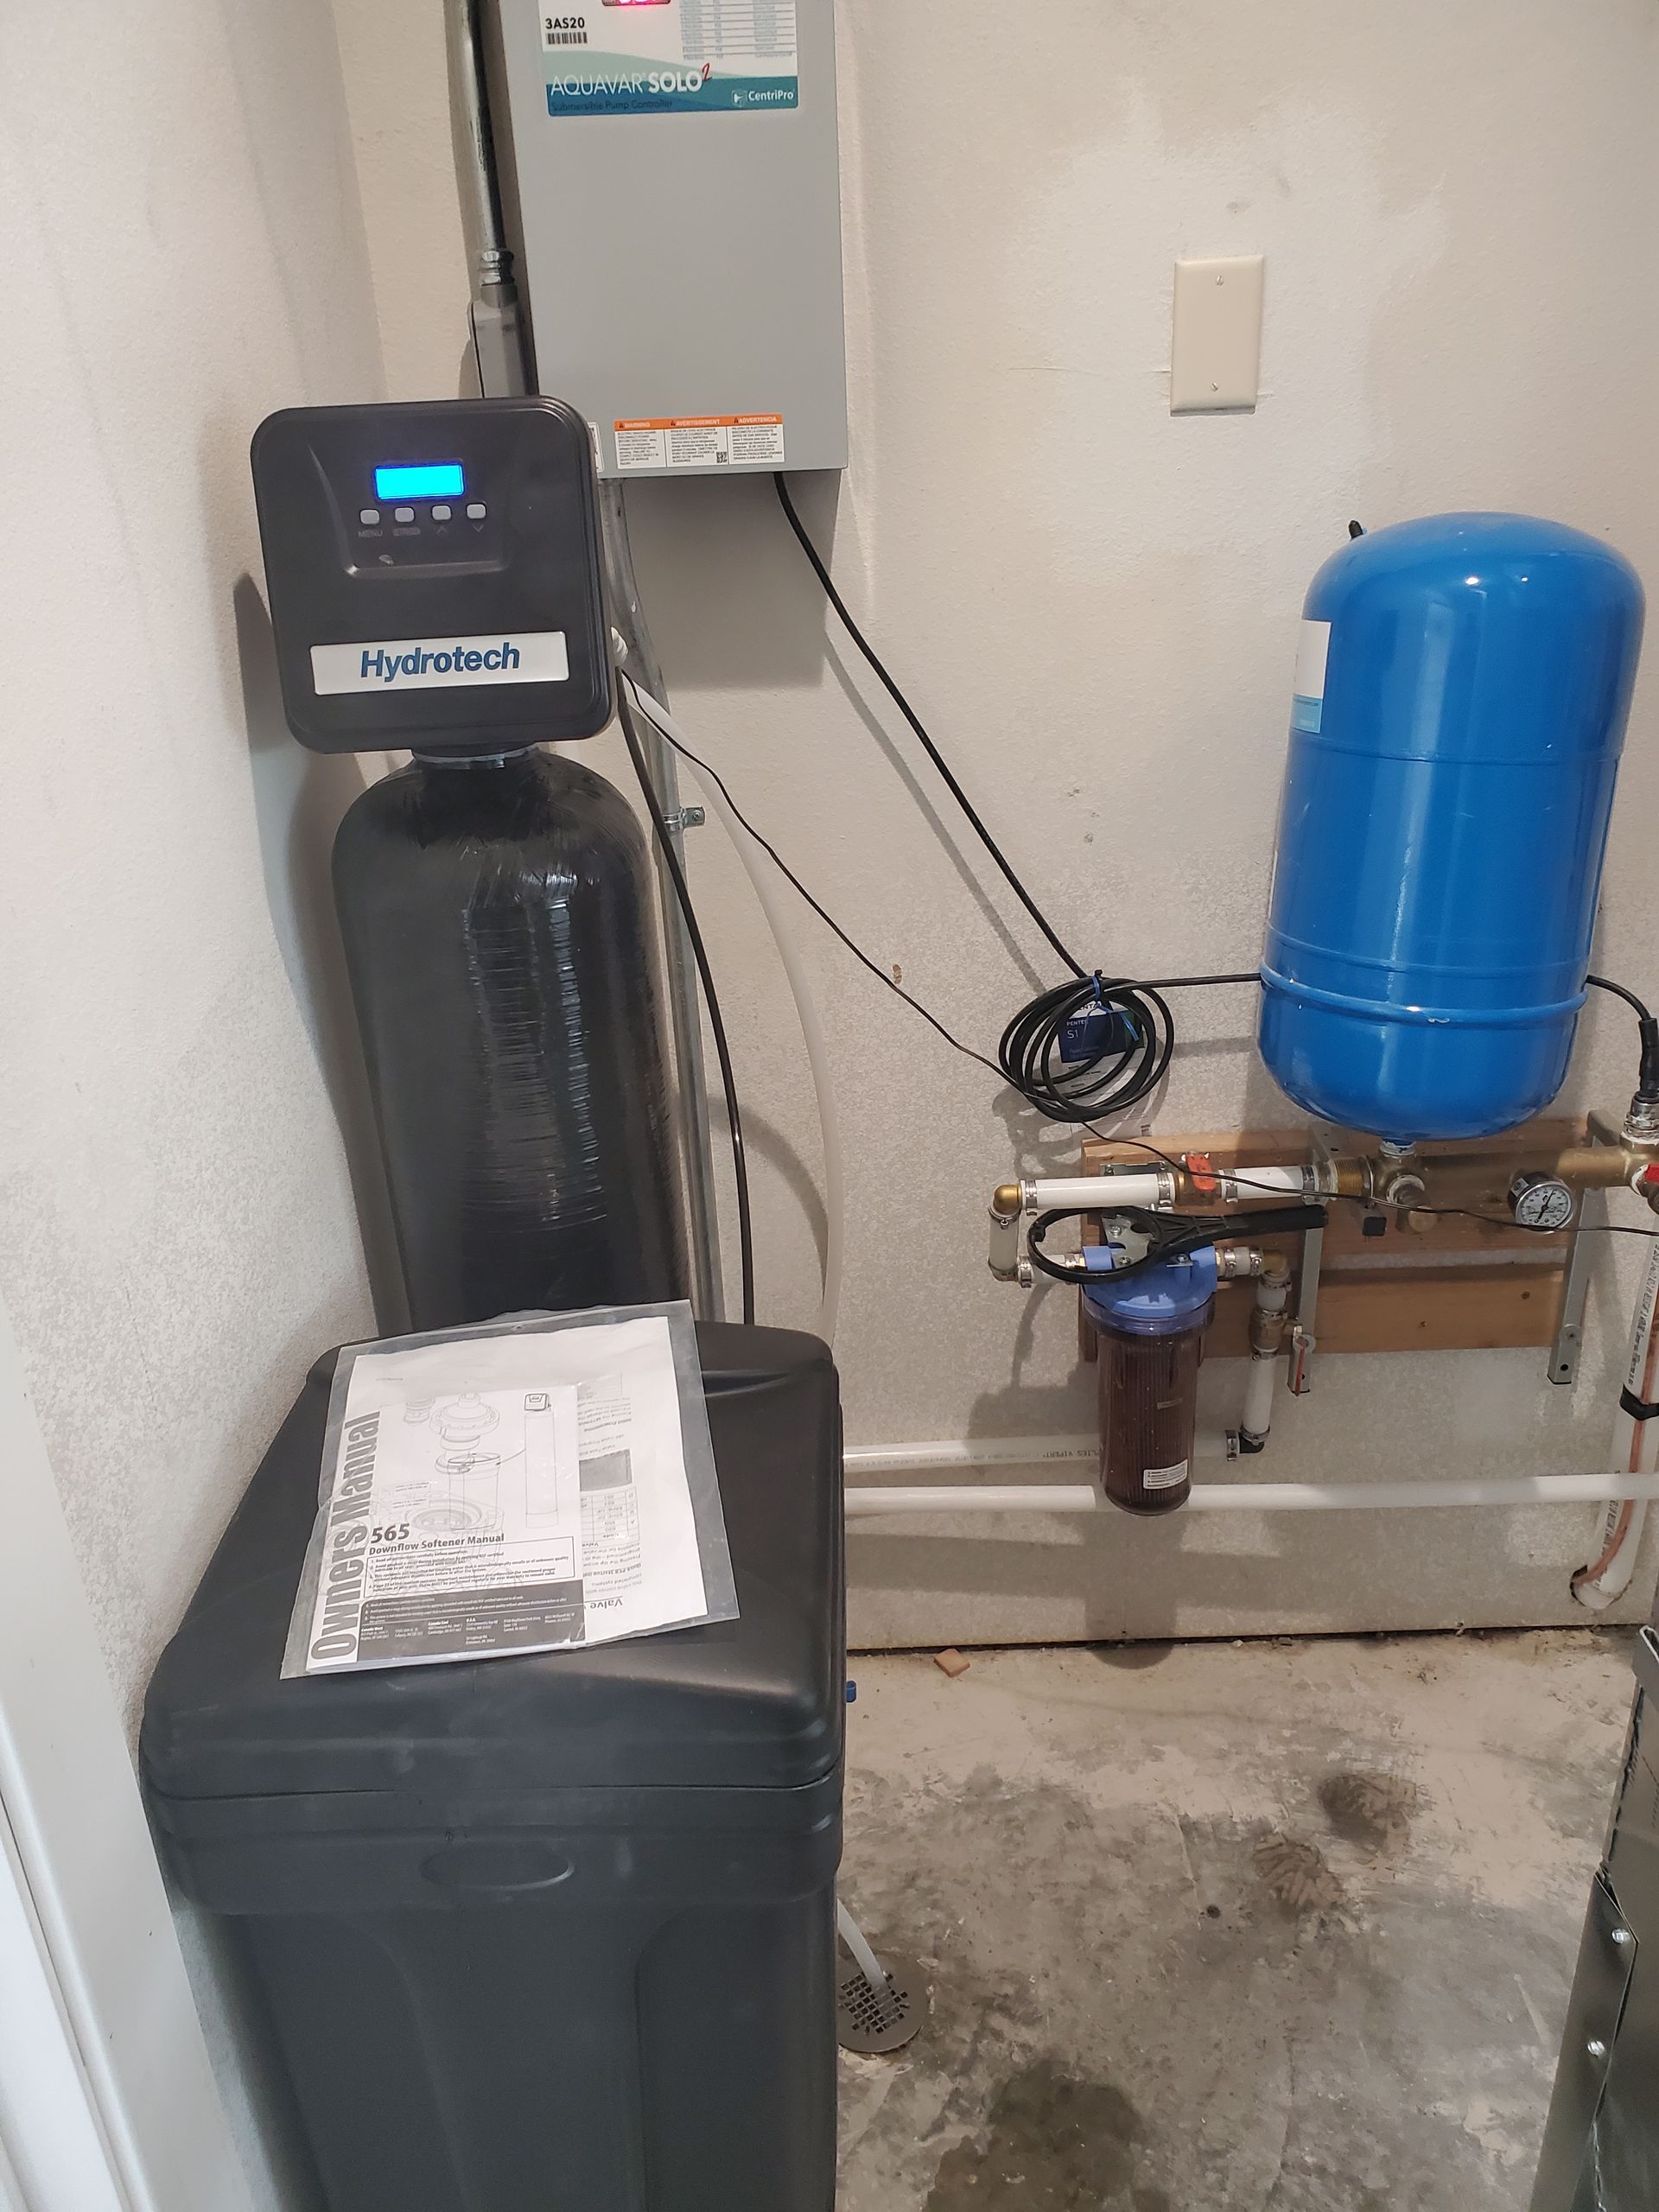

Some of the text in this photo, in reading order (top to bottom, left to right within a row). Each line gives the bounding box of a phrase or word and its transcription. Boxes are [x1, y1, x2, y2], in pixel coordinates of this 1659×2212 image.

[545, 16, 585, 29] 3AS20
[550, 73, 644, 96] AQUAVAR
[748, 89, 794, 101] CentriPro
[552, 99, 672, 111] Submersible Pump Controller
[360, 642, 520, 683] Hydrotech
[1067, 1029, 1078, 1039] S1
[310, 1411, 380, 1660] Owners Manual
[370, 1522, 410, 1544] 565
[369, 1533, 505, 1556] Downflow Softener Manual
[589, 1598, 623, 1610] Valve
